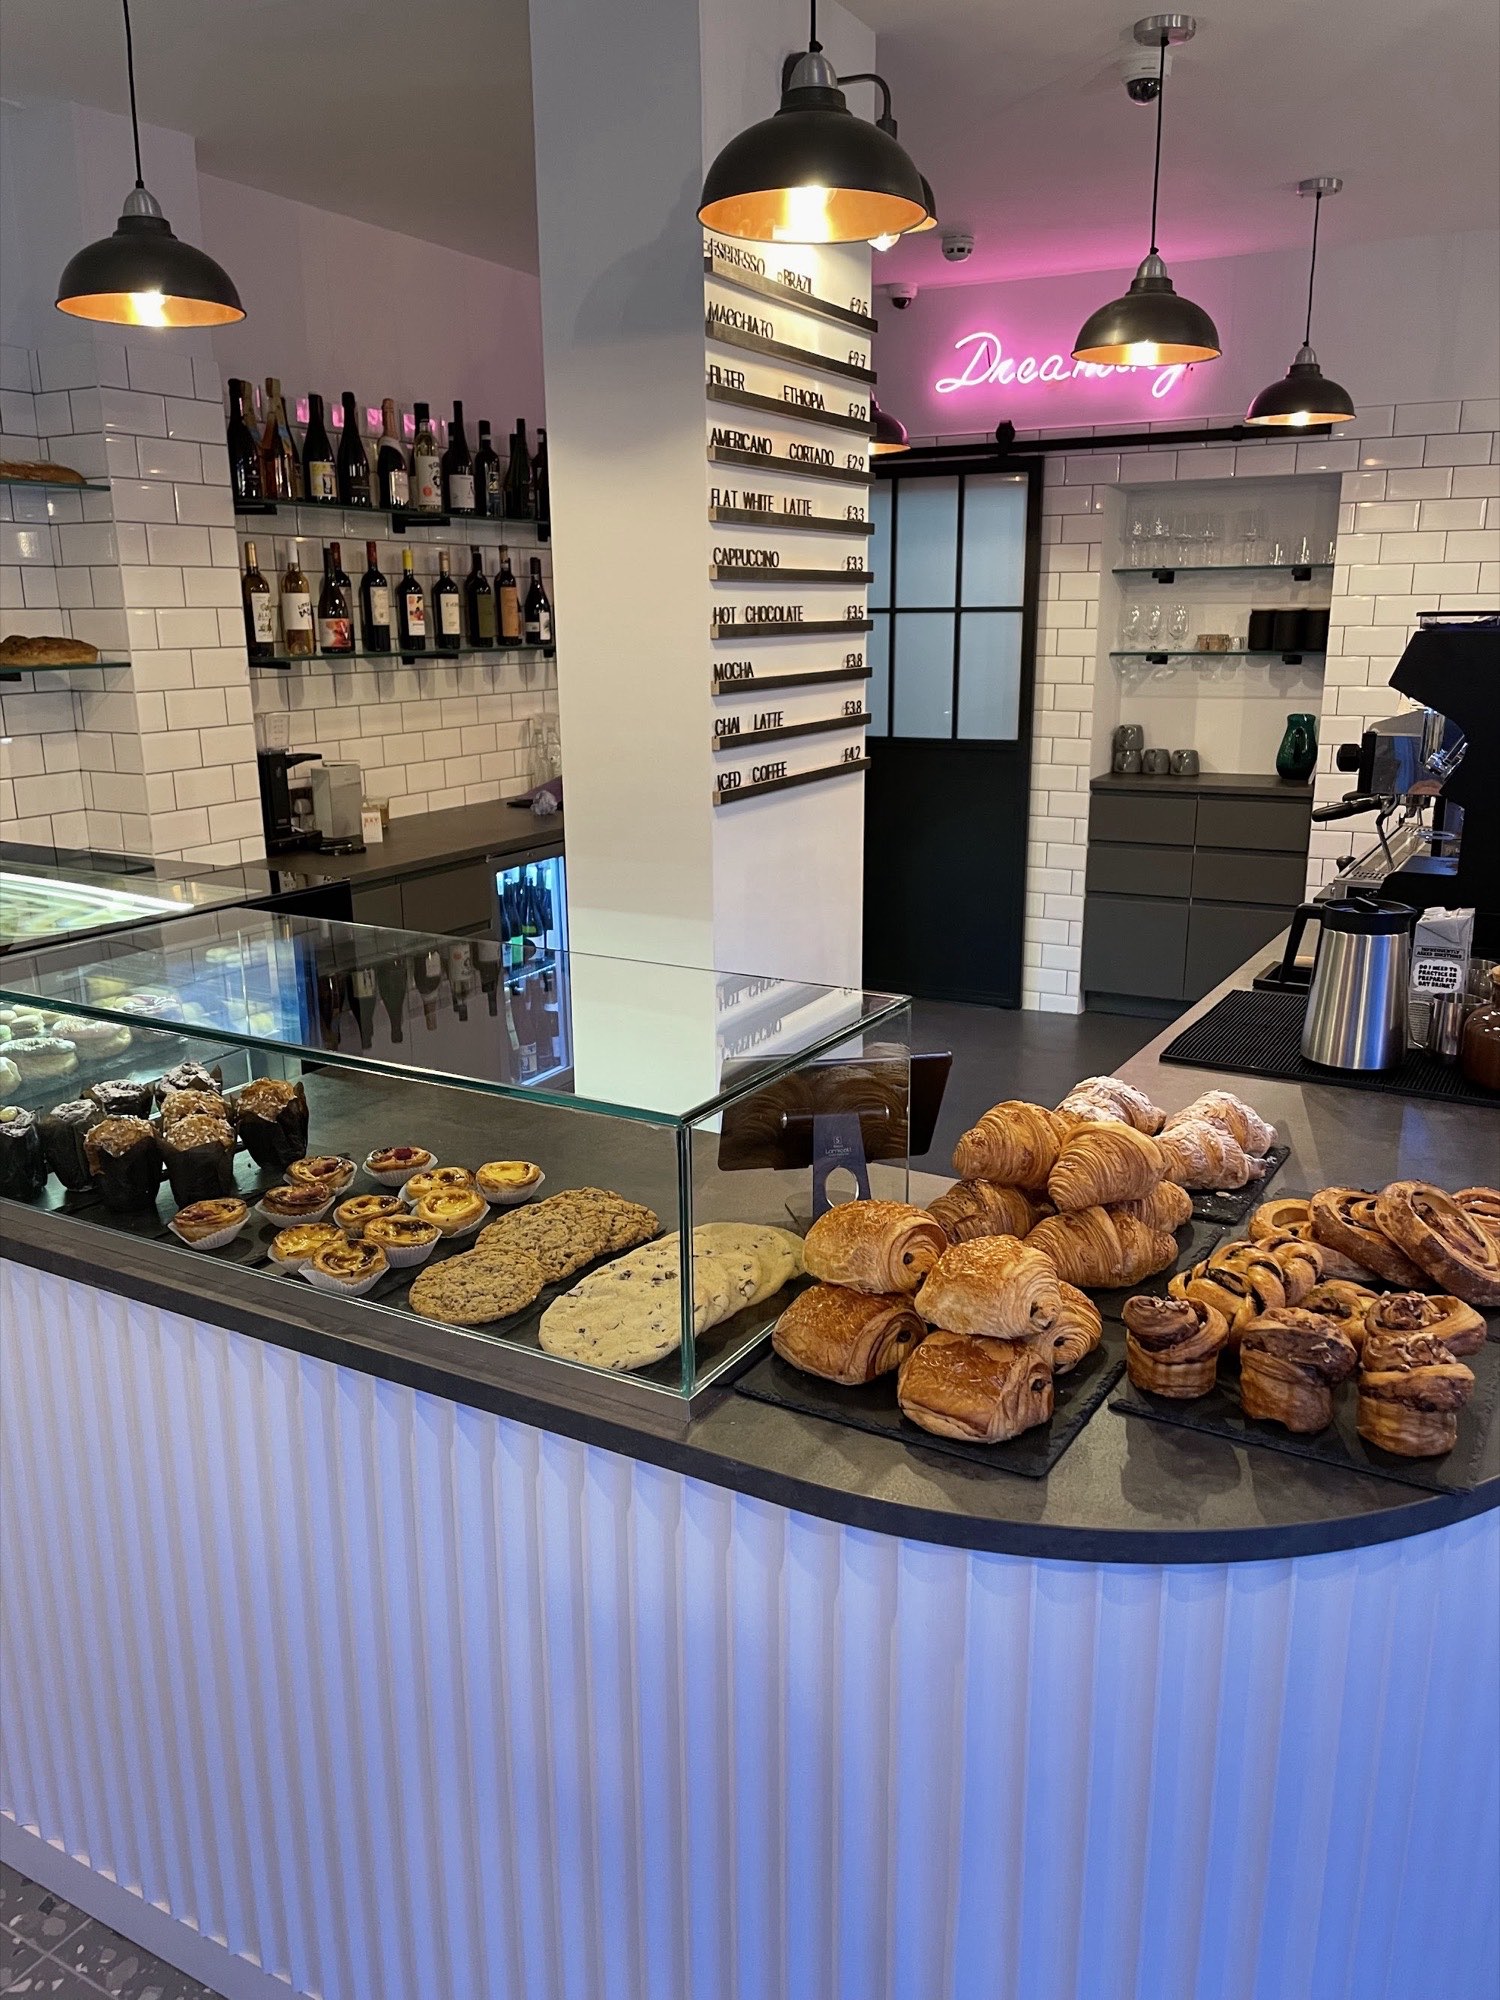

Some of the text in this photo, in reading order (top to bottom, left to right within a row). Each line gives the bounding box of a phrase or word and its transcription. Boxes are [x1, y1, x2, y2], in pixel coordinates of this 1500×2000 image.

[708, 301, 773, 339] MACCHIATO
[783, 385, 825, 411] ETHIOPIA
[710, 427, 773, 455] AMERICANO
[789, 443, 835, 466] CORTADO
[711, 488, 739, 509] FLAT
[743, 491, 774, 513] WHITE
[783, 497, 812, 517] LATTE
[713, 547, 780, 568] CAPPUCCINO
[713, 606, 737, 624] HOT
[745, 605, 804, 623] CHOCOLATE
[713, 662, 755, 684] MOCHA
[714, 716, 741, 738] CHAI
[754, 711, 784, 731] LATTE
[717, 771, 742, 791] ICED
[752, 761, 788, 783] COFFEE
